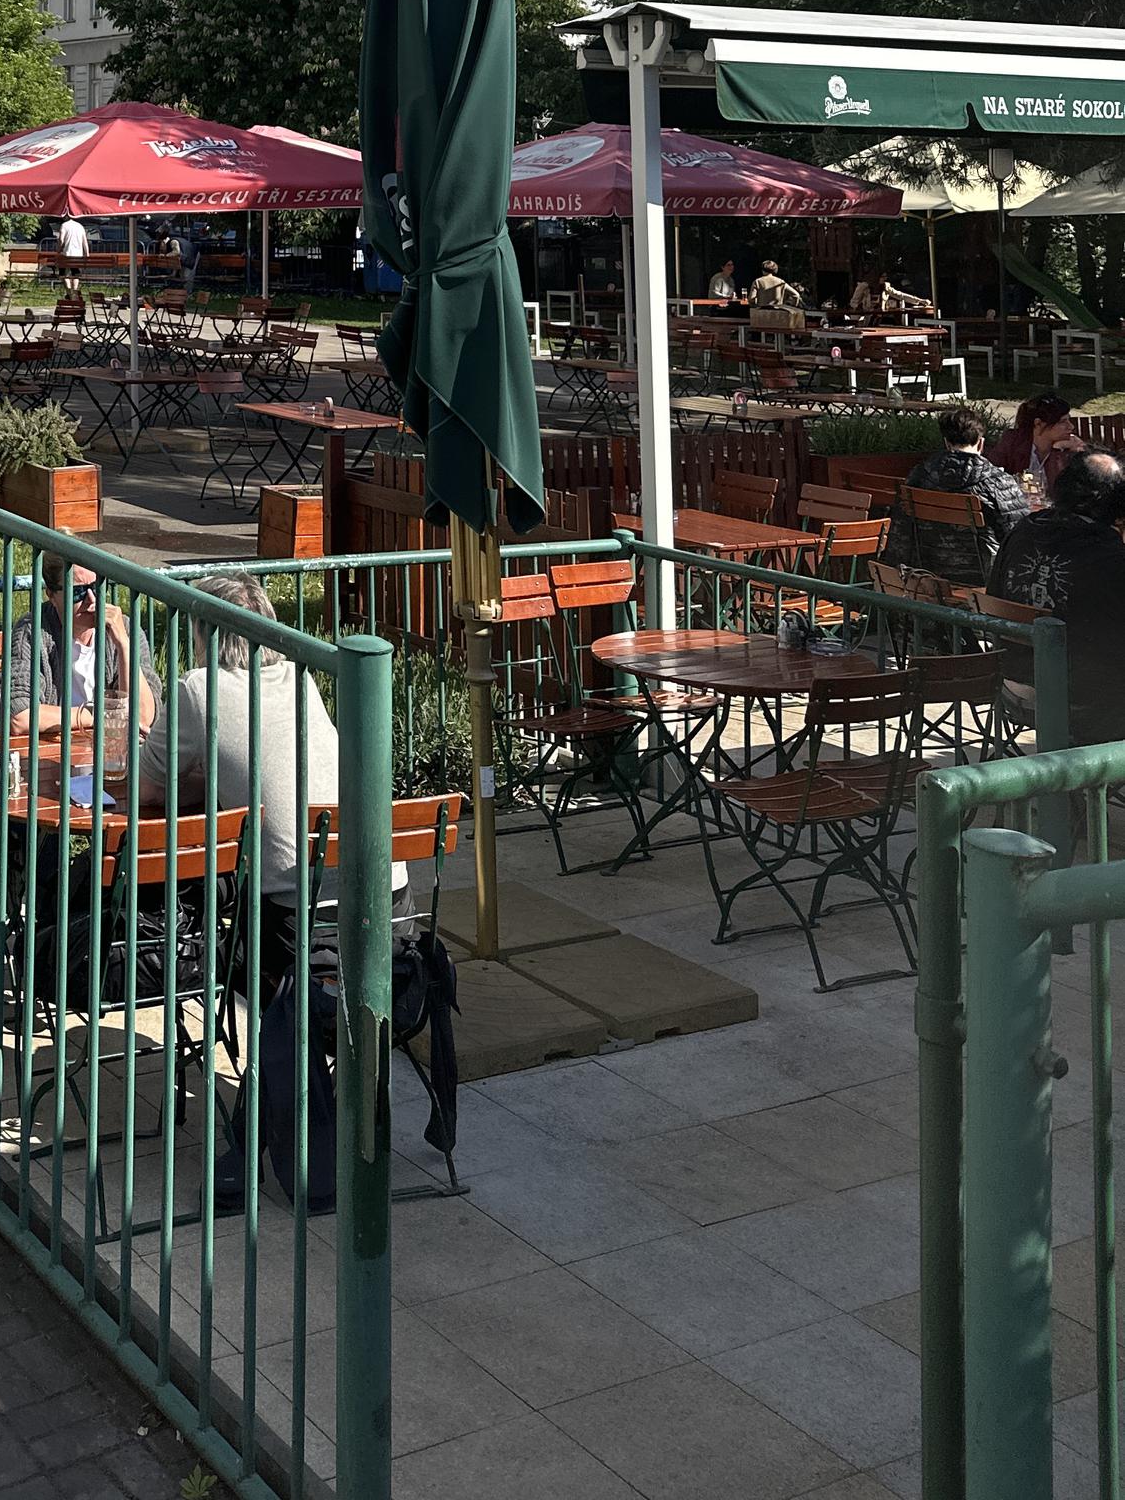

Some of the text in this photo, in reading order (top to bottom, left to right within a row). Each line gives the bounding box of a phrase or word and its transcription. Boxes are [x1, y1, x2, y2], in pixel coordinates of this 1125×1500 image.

[982, 93, 1125, 119] NA STARÉ SOKOL
[118, 187, 363, 207] PIVO ROCKU TŘI SESTRY
[506, 194, 582, 211] AHRADÍŠ
[664, 195, 861, 211] IVO ROCKU TŘI SESTRY
